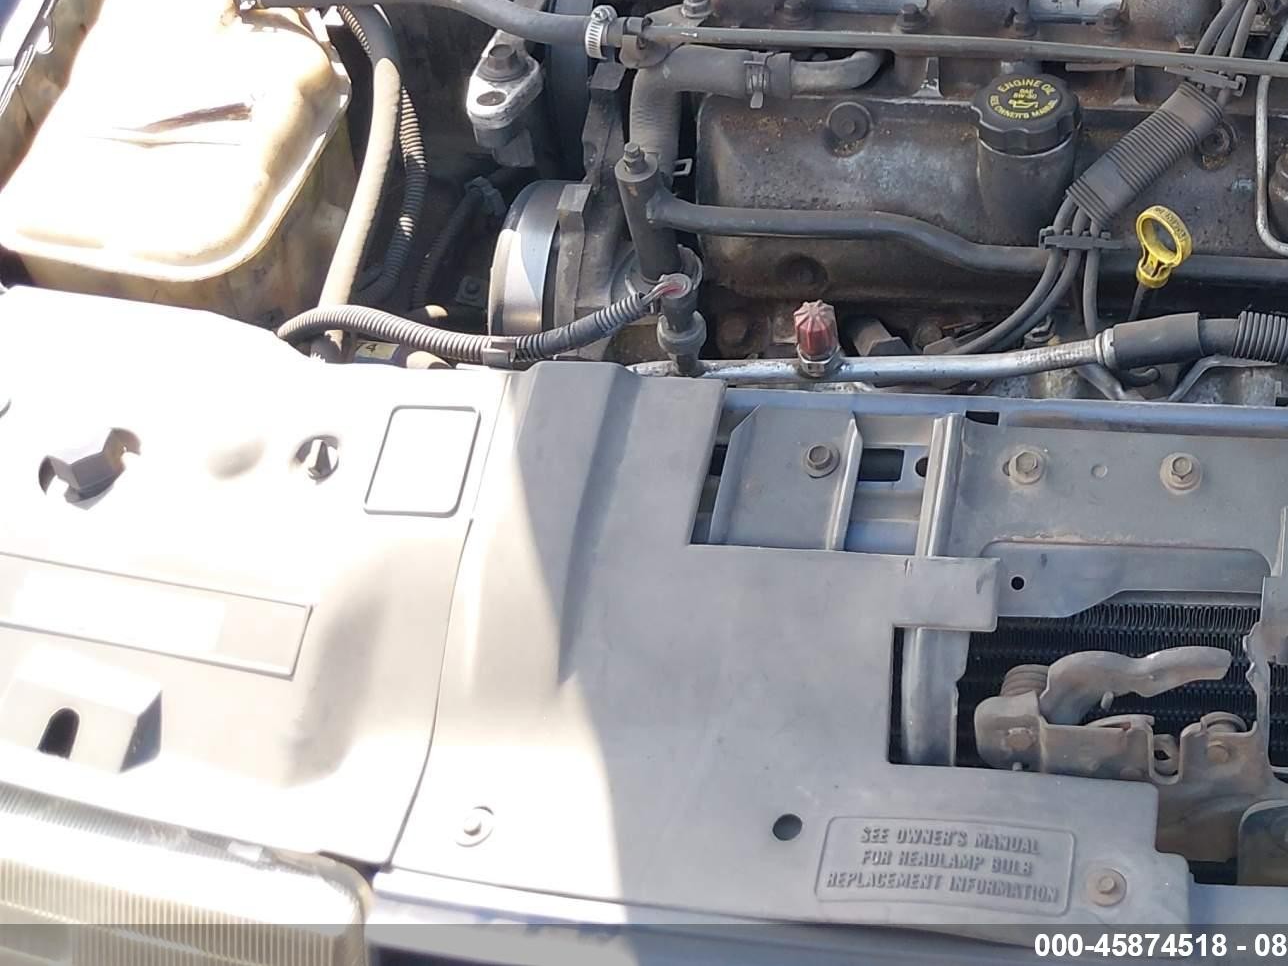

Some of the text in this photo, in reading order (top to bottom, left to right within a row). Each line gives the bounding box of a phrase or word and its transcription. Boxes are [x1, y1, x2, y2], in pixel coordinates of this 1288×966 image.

[998, 79, 1043, 92] ENGINE
[860, 826, 1041, 855] SEE OWNER'S MANUAL
[861, 850, 1033, 876] FOR HEADLAMP BULB
[826, 872, 1059, 903] REPLACEMENT INFORMATION
